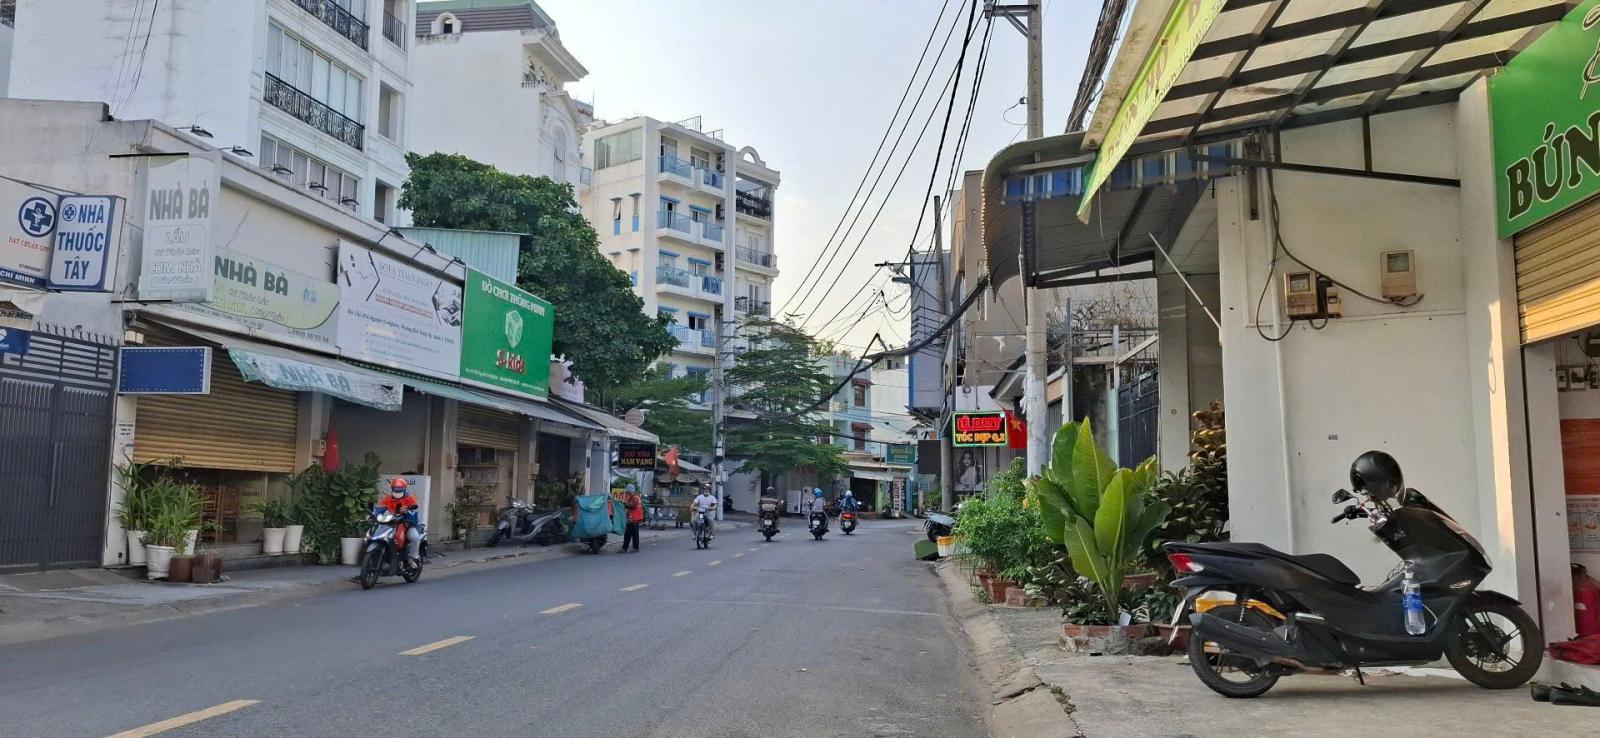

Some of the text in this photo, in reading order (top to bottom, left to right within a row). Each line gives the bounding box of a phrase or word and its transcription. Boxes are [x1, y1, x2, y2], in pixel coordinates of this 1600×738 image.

[1506, 111, 1600, 222] BÚN
[78, 200, 104, 224] NHÀ
[149, 180, 209, 221] NHÀ BÀ
[57, 225, 104, 252] THUỐC
[15, 273, 36, 285] MINH
[64, 255, 90, 280] TÂY
[214, 255, 258, 288] NHÀ
[263, 272, 289, 297] BÀ
[481, 278, 493, 295] ĐỒ
[325, 371, 351, 393] BÀ
[955, 430, 973, 442] TÓC
[971, 417, 1002, 431] DUY
